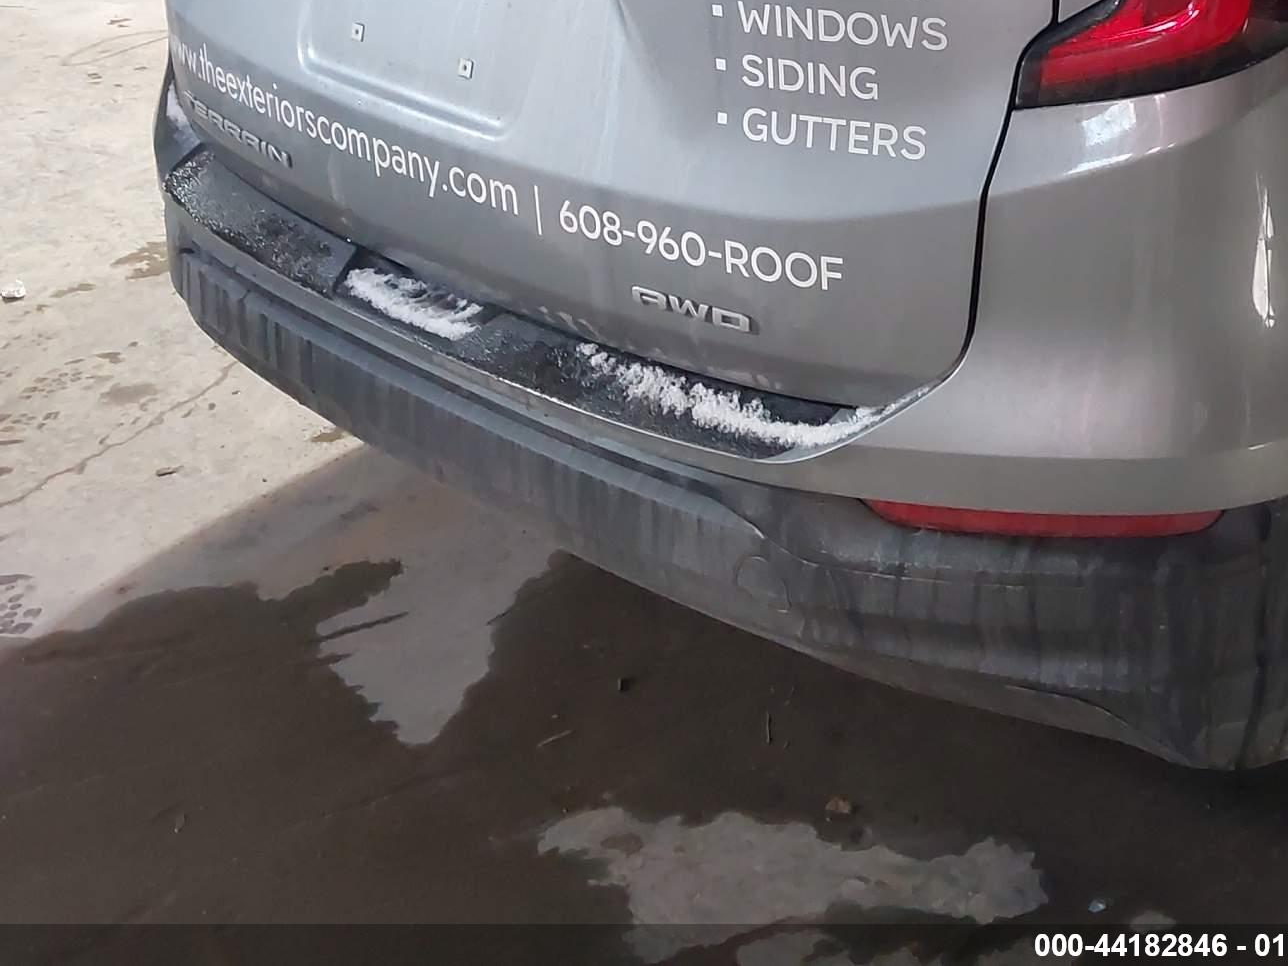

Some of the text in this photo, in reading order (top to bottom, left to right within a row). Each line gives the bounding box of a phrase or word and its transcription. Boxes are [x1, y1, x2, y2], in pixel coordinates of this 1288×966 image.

[738, 1, 948, 51] WINDOWS
[741, 54, 879, 100] SIDING
[184, 89, 293, 168] TERRAIN
[742, 107, 927, 160] GUTTERS
[559, 200, 844, 291] 608-960-ROOF
[631, 285, 755, 333] AWD
